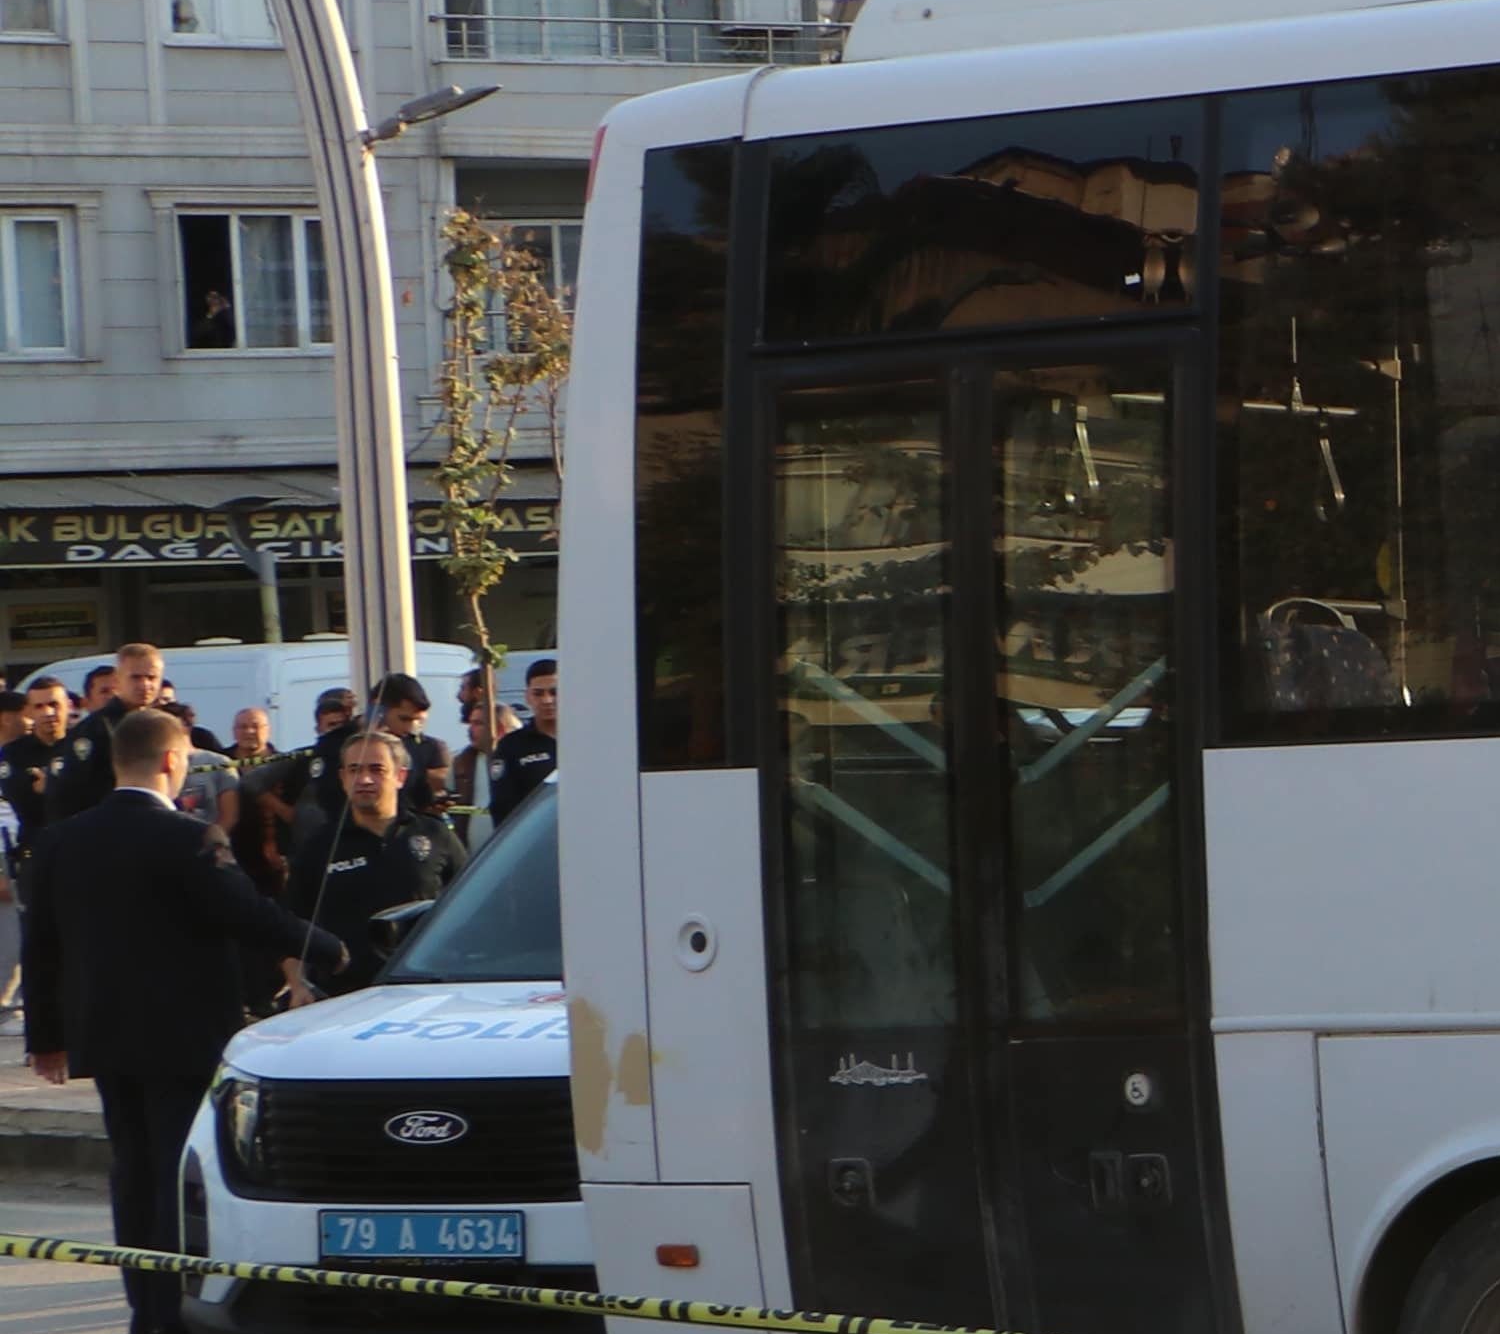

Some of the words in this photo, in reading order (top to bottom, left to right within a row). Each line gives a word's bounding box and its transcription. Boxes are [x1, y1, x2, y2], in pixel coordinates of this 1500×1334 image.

[53, 512, 232, 543] BULGUR
[399, 1114, 451, 1139] Ford
[339, 1217, 376, 1251] 79
[399, 1217, 416, 1251] A
[438, 1217, 515, 1251] 4634
